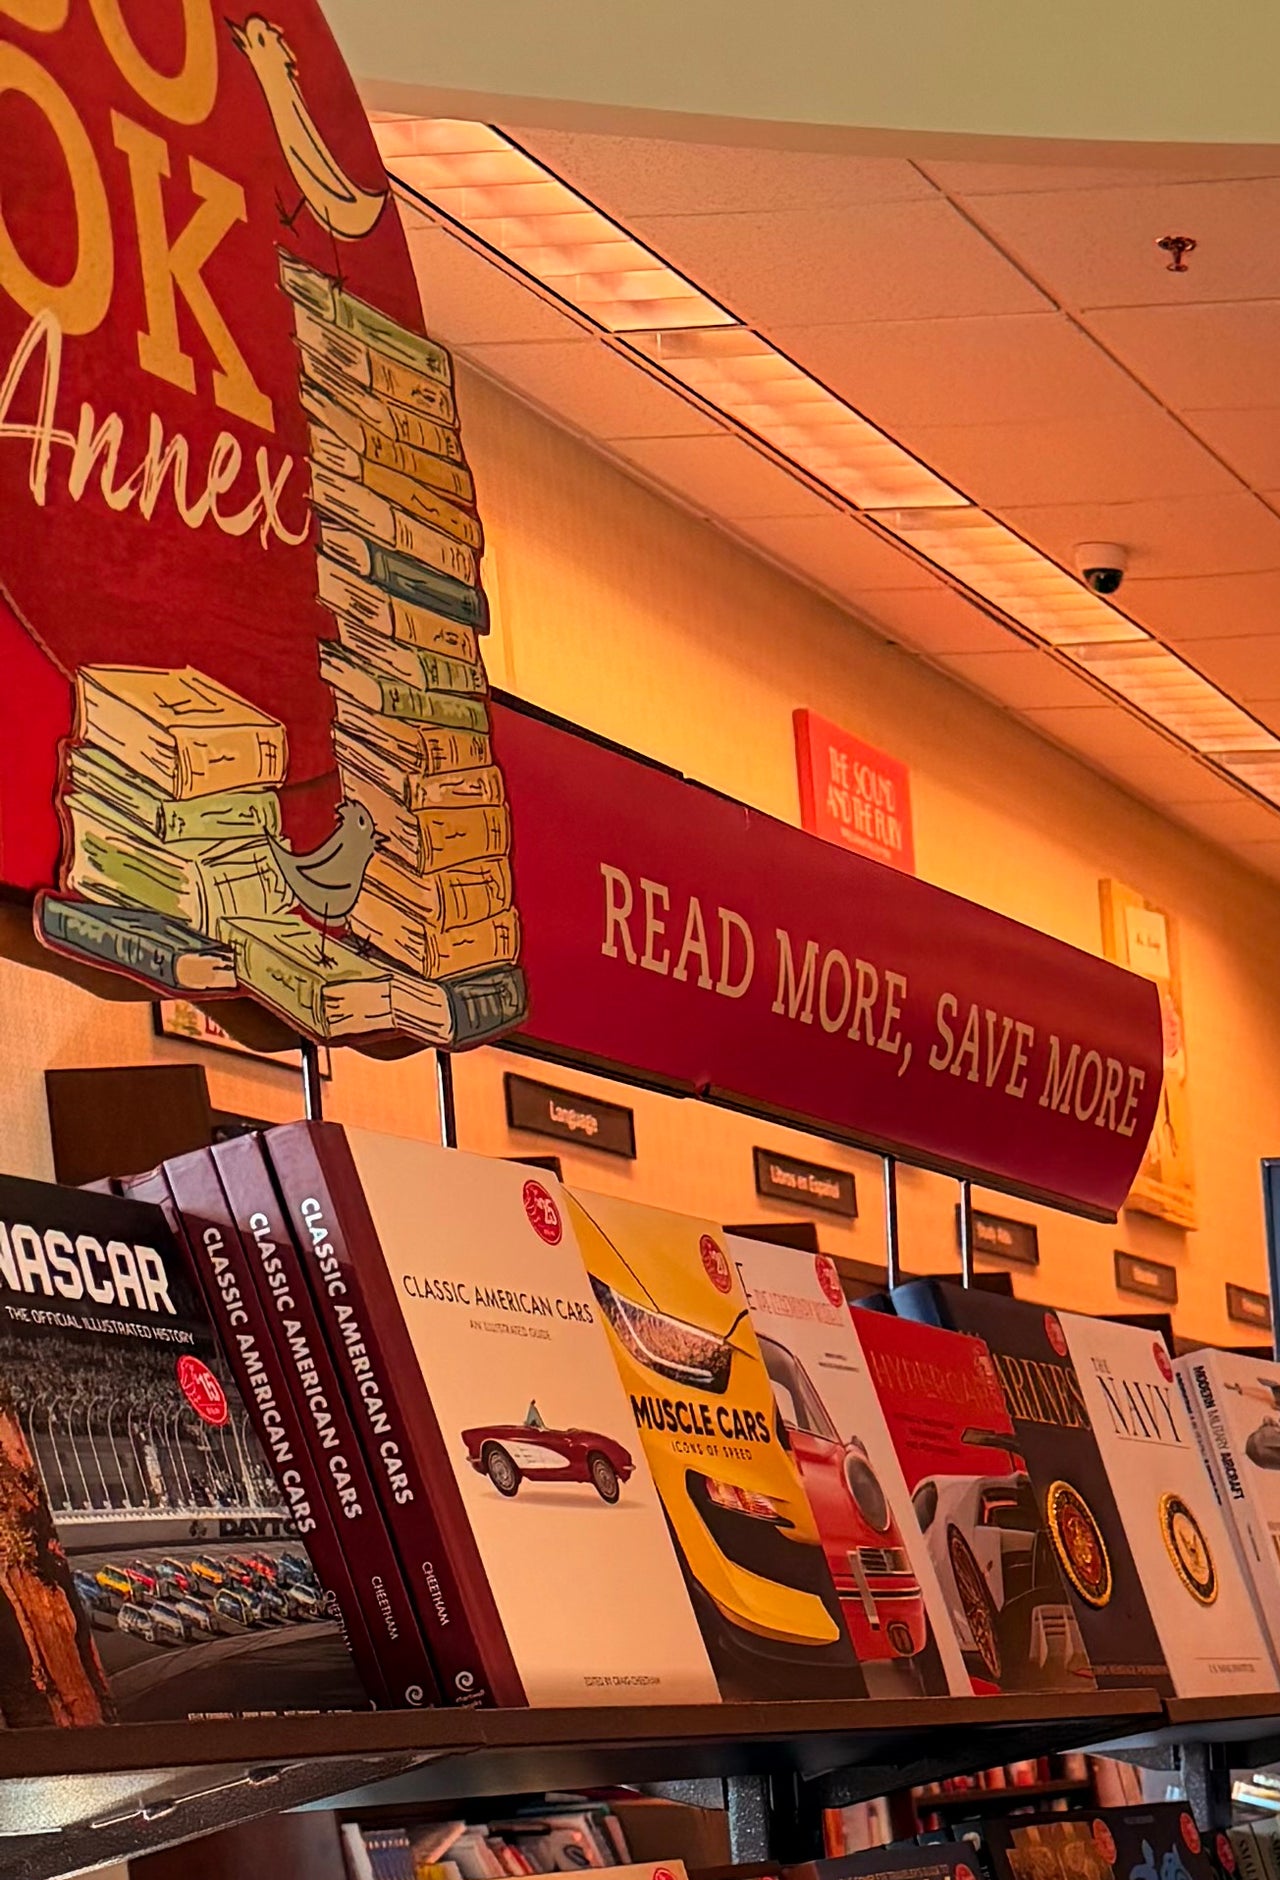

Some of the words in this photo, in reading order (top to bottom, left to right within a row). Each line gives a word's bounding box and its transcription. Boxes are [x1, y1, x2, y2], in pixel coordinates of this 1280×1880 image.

[0, 308, 313, 549] Annex
[600, 862, 756, 998] READ
[772, 928, 912, 1076] MORE,
[929, 992, 1035, 1098] SAVE
[1039, 1034, 1146, 1137] MORE
[0, 1219, 176, 1315] NASCAR
[402, 1275, 470, 1304] CLASSIC
[474, 1287, 553, 1318] AMERICAN
[557, 1298, 595, 1325] CARS
[5, 1305, 30, 1323] THE
[154, 1324, 195, 1346] HISTORY
[301, 1198, 346, 1297] CLASSIC
[335, 1303, 390, 1435] AMERICAN
[380, 1439, 414, 1505] CARS
[630, 1395, 713, 1437] MUSCLE
[716, 1404, 771, 1445] CARS
[1097, 1375, 1182, 1442] NAVY
